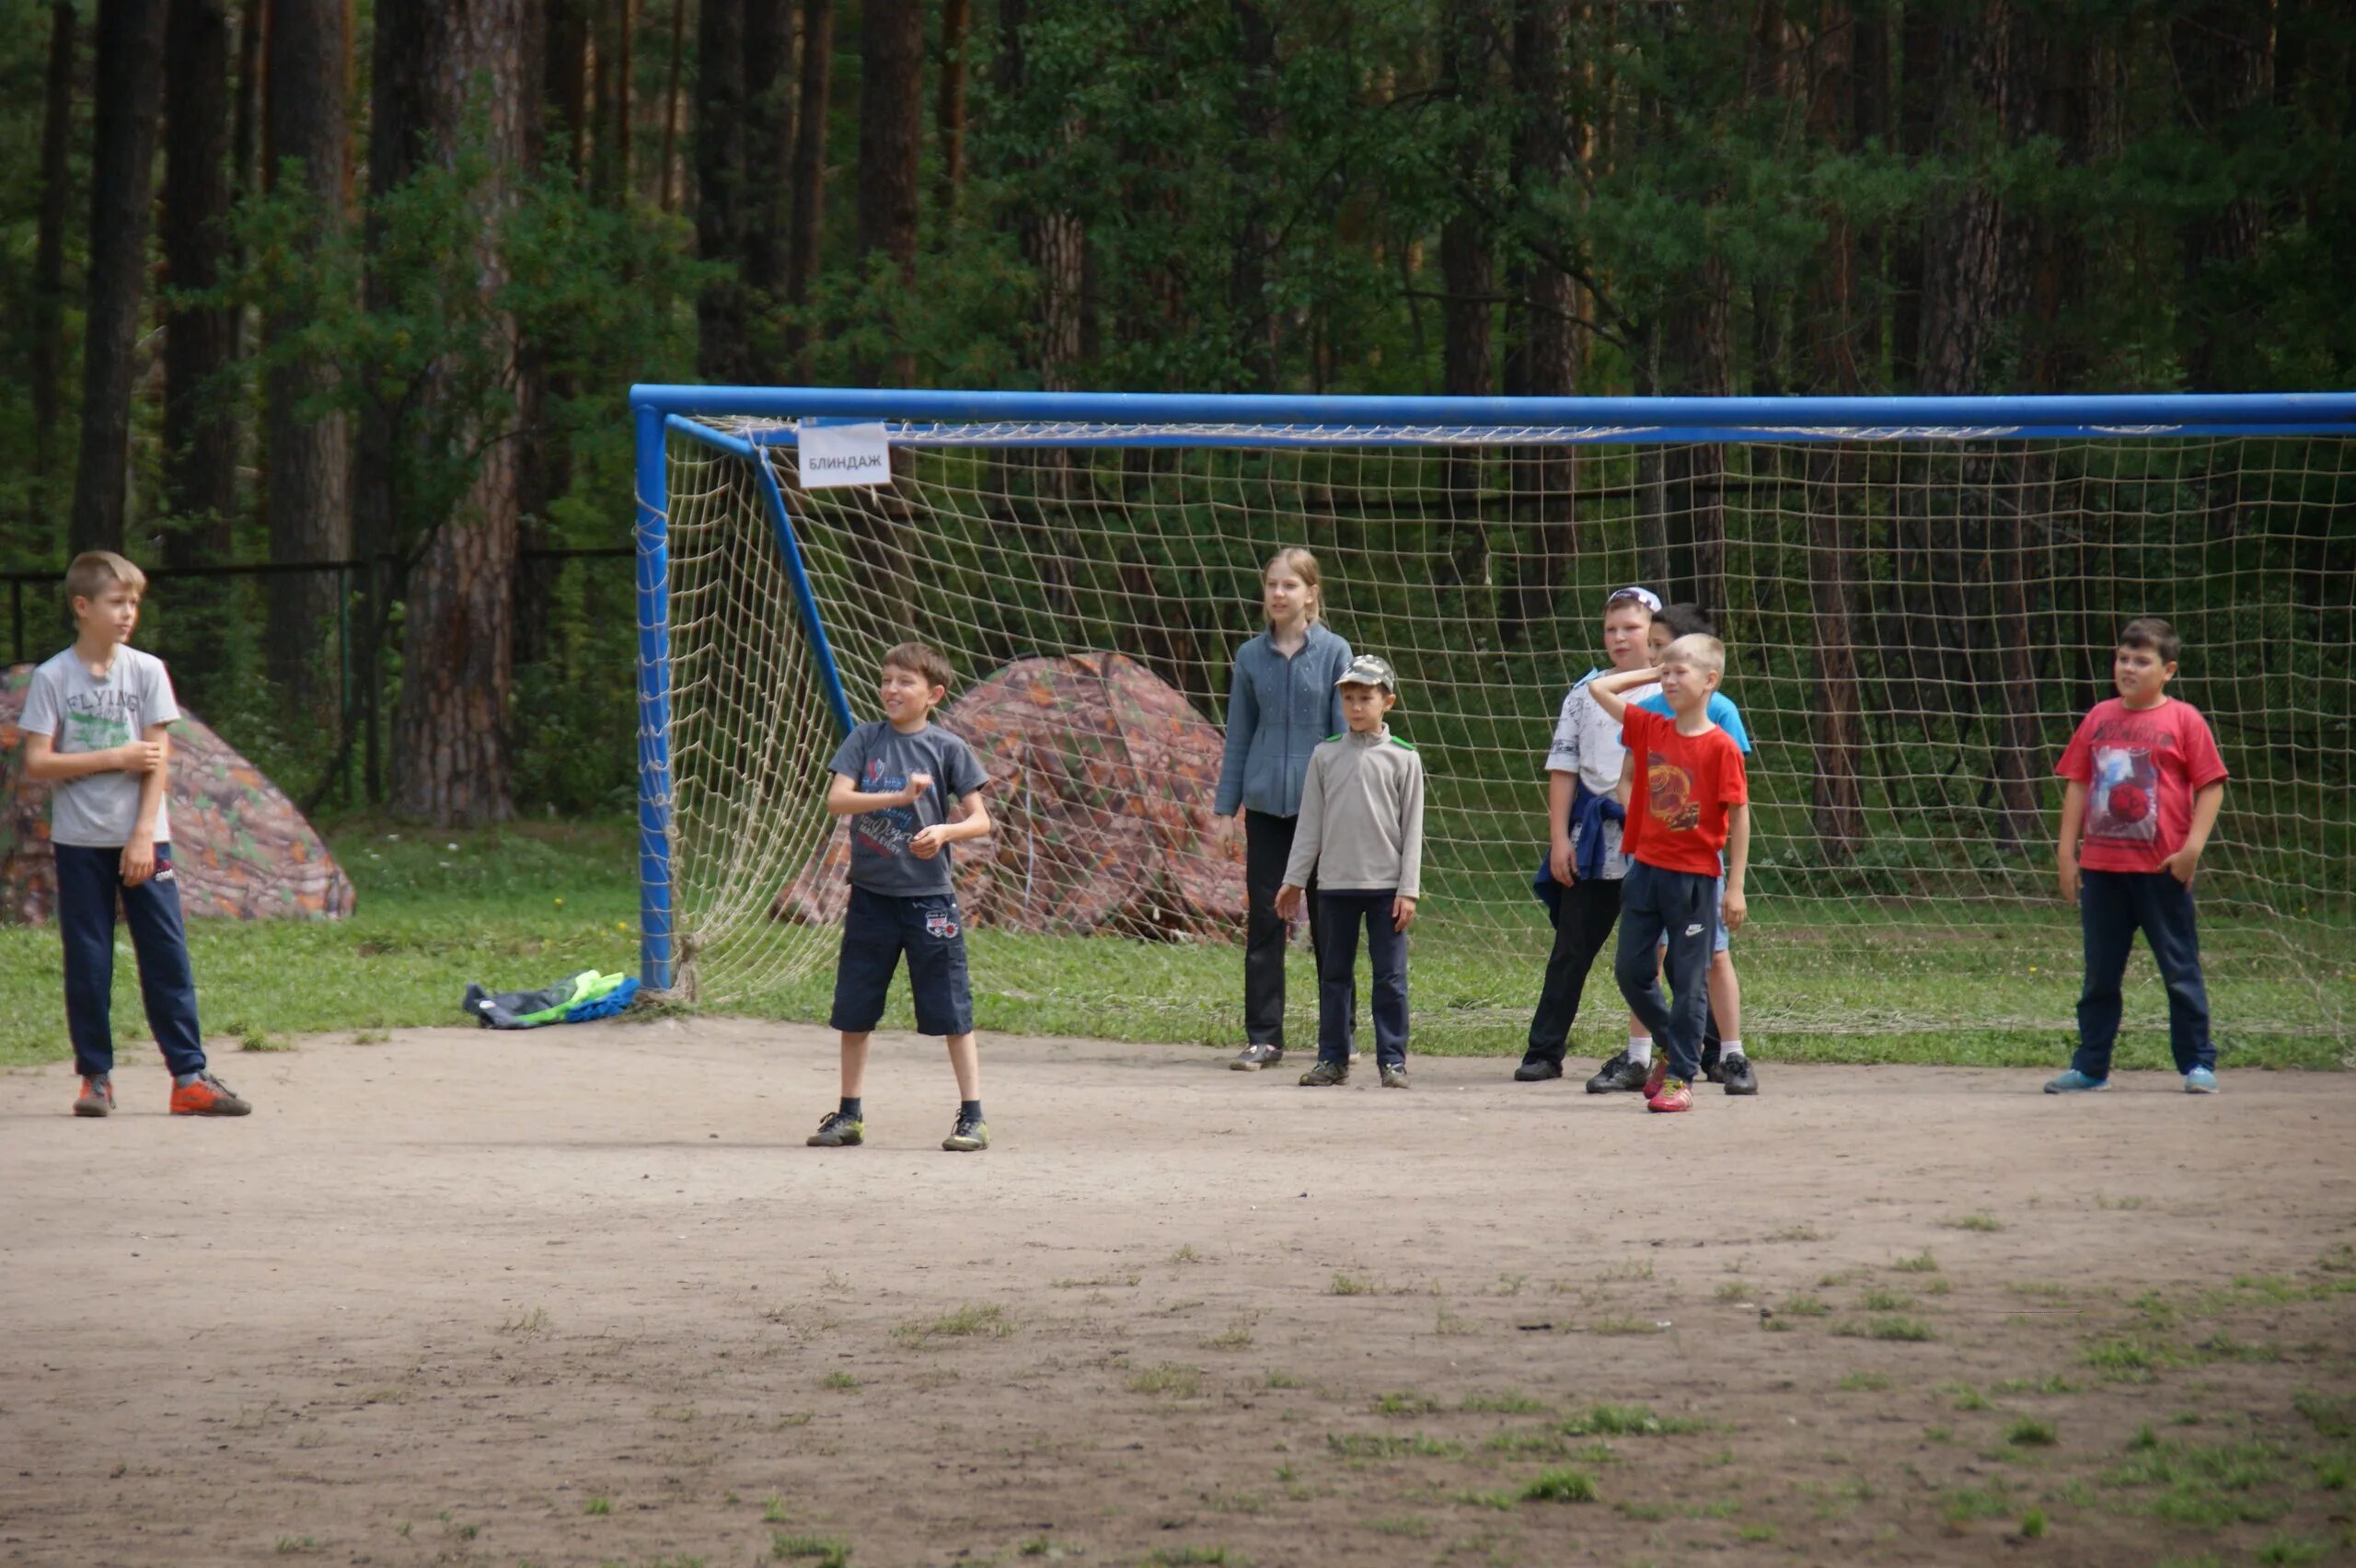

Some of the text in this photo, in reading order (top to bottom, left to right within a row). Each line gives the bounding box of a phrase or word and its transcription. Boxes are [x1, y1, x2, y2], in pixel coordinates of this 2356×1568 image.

[809, 455, 882, 470] БЛИНДАЖ
[66, 690, 140, 712] FLYING
[878, 836, 902, 855] EVERY
